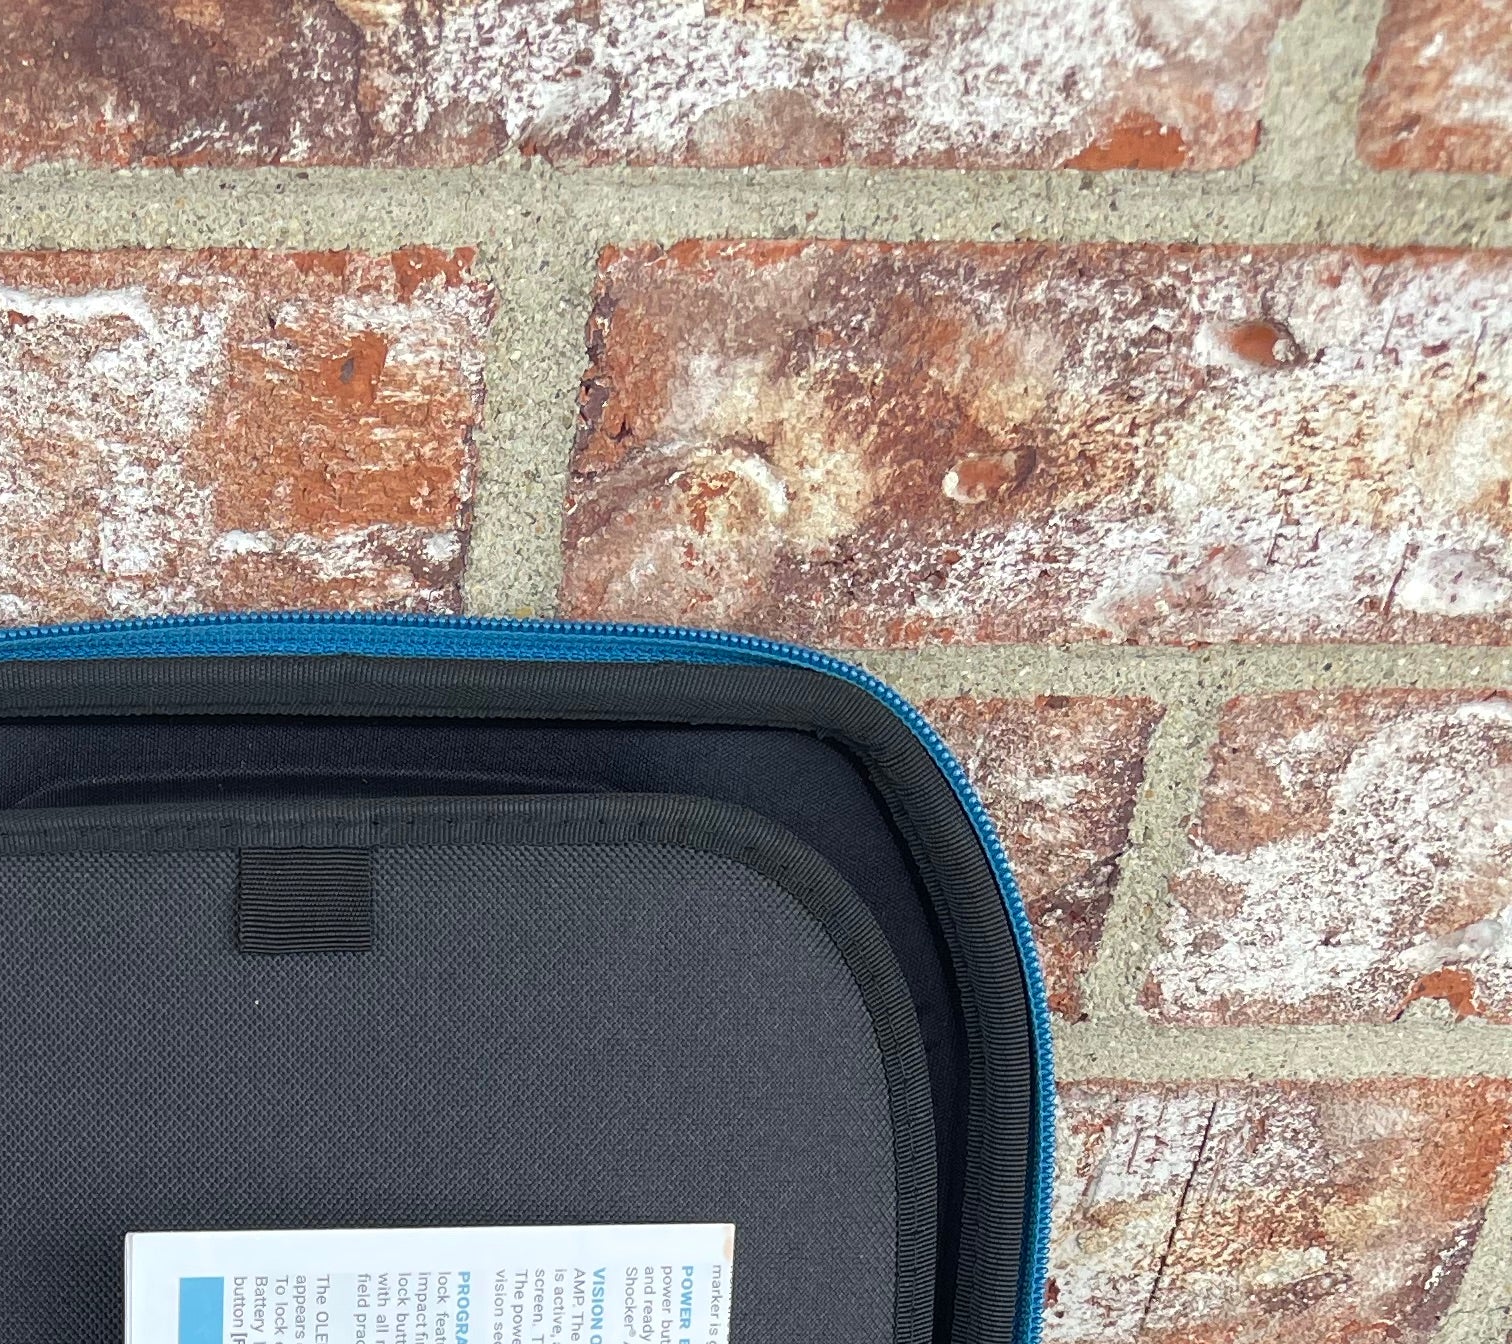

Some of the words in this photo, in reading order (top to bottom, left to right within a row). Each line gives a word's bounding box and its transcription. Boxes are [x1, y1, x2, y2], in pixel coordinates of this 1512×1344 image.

[250, 1276, 268, 1332] Battery
[357, 1273, 371, 1307] field
[377, 1273, 391, 1307] with
[397, 1273, 411, 1306] lock
[415, 1272, 431, 1328] impact
[437, 1272, 451, 1304] lock
[494, 1269, 507, 1317] vision
[514, 1269, 528, 1299] The
[590, 1267, 606, 1330] VISION
[661, 1266, 672, 1313] power
[680, 1266, 694, 1329] POWER
[711, 1265, 723, 1319] marker
[274, 1302, 288, 1335] lock
[293, 1275, 306, 1339] appears
[376, 1315, 389, 1332] all
[571, 1311, 584, 1341] The
[639, 1300, 654, 1341] ready
